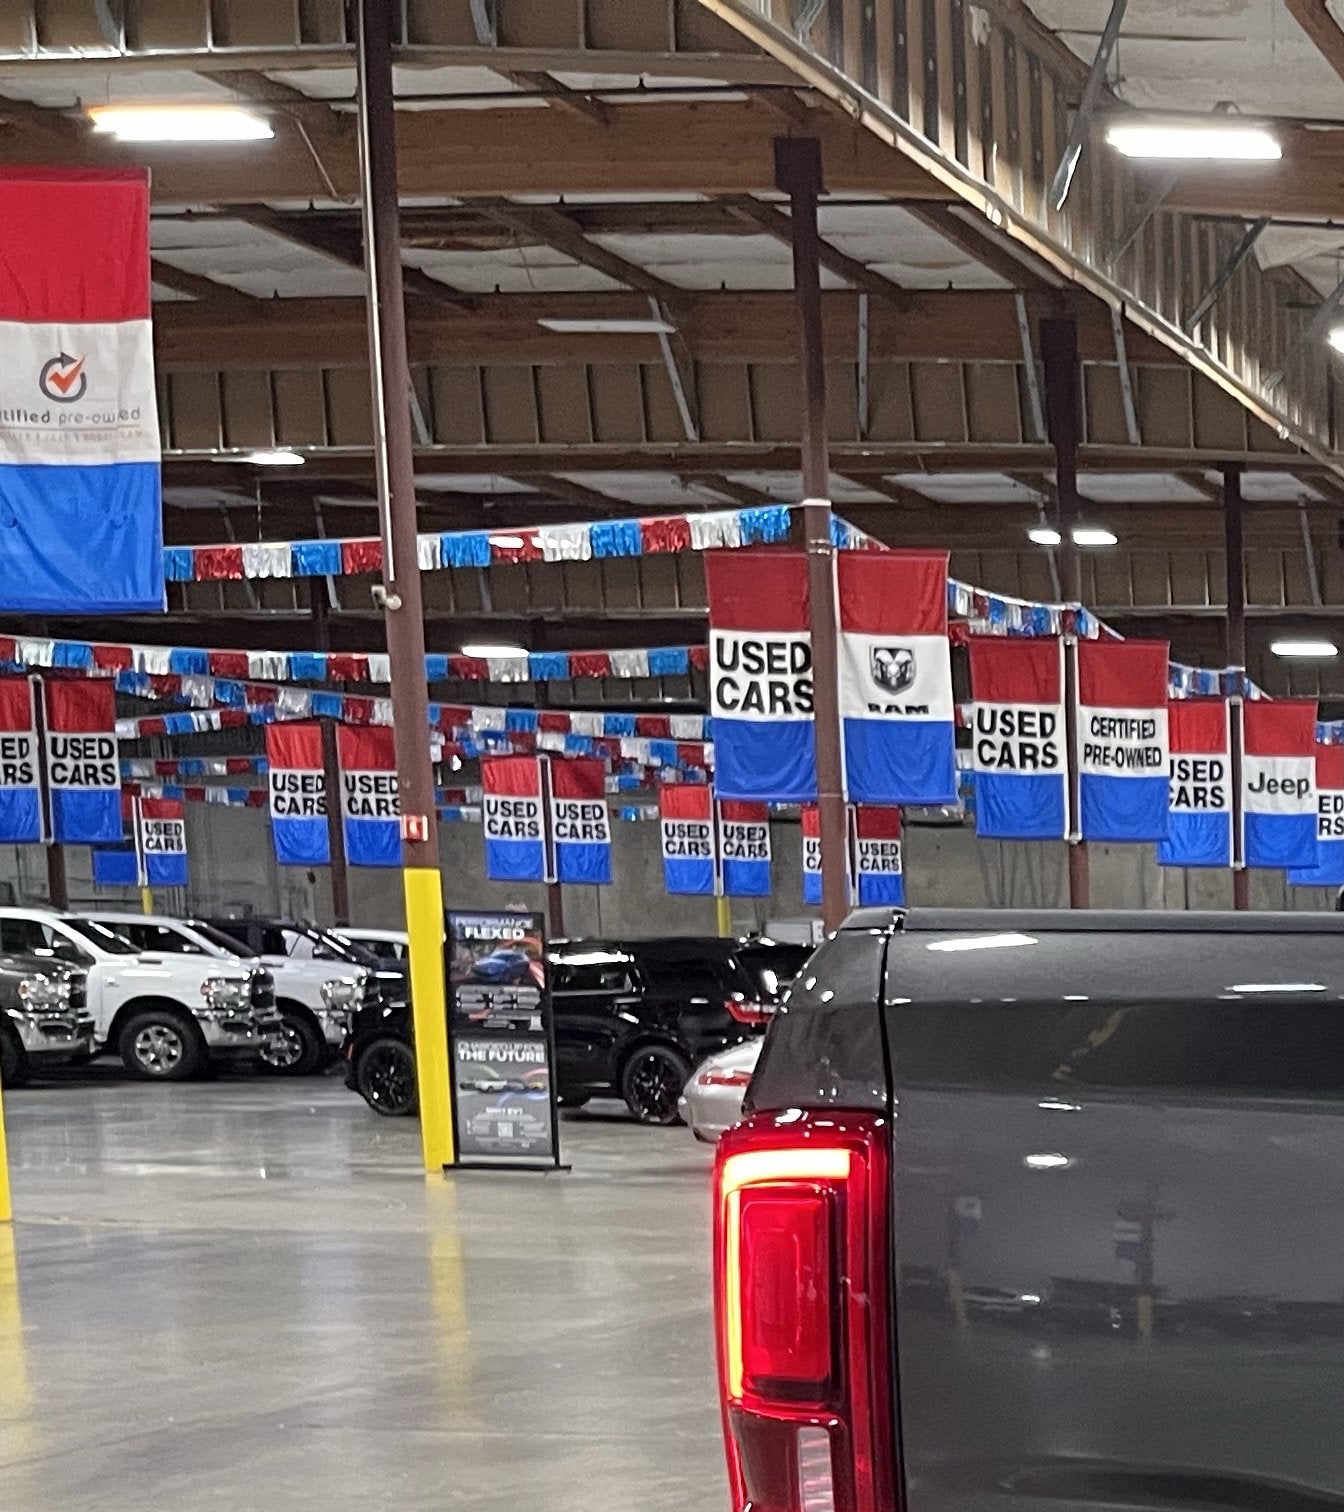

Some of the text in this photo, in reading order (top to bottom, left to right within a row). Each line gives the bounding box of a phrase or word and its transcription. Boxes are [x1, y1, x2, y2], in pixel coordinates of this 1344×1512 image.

[0, 409, 50, 424] tified
[716, 638, 812, 674] USED
[716, 677, 814, 714] CARS
[977, 708, 1056, 739] USED
[1091, 716, 1156, 739] CERTIFIED
[0, 738, 30, 760] ED
[51, 737, 115, 760] USED
[978, 739, 1058, 769] CARS
[1083, 743, 1162, 768] PRE-OWNED
[0, 762, 33, 785] RS
[51, 762, 116, 785] CARS
[272, 773, 324, 793] USED
[345, 775, 398, 794] USED
[1248, 772, 1310, 800] Jeep
[273, 795, 326, 815] CARS
[1169, 786, 1226, 809] ARS
[1318, 795, 1344, 814] ED
[486, 799, 538, 818] USED
[555, 803, 604, 821] USED
[144, 822, 182, 836] USED
[487, 819, 540, 837] CARS
[555, 822, 607, 840] CARS
[664, 822, 709, 838] USED
[723, 824, 767, 842] USED
[1318, 817, 1344, 836] RS
[145, 837, 183, 851] CARS
[664, 840, 712, 855] CARS
[723, 841, 768, 858] CARS
[859, 842, 898, 856] USED
[859, 856, 900, 872] CARS
